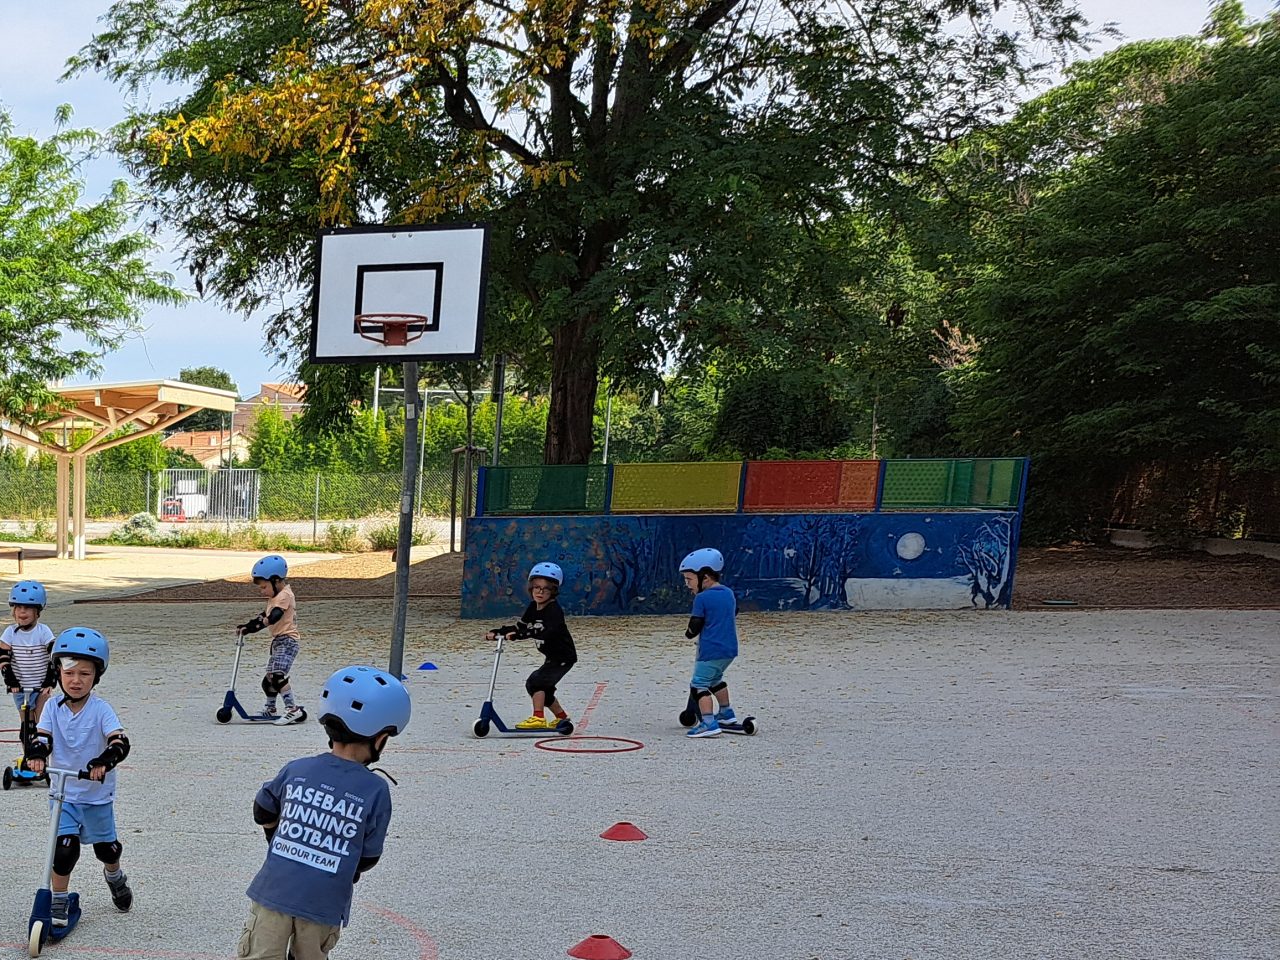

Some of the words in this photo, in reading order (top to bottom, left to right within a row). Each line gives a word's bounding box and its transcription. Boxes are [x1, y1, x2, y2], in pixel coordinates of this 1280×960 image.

[285, 784, 364, 823] BASEBALL
[290, 847, 310, 860] OUR
[310, 854, 336, 868] TEAM
